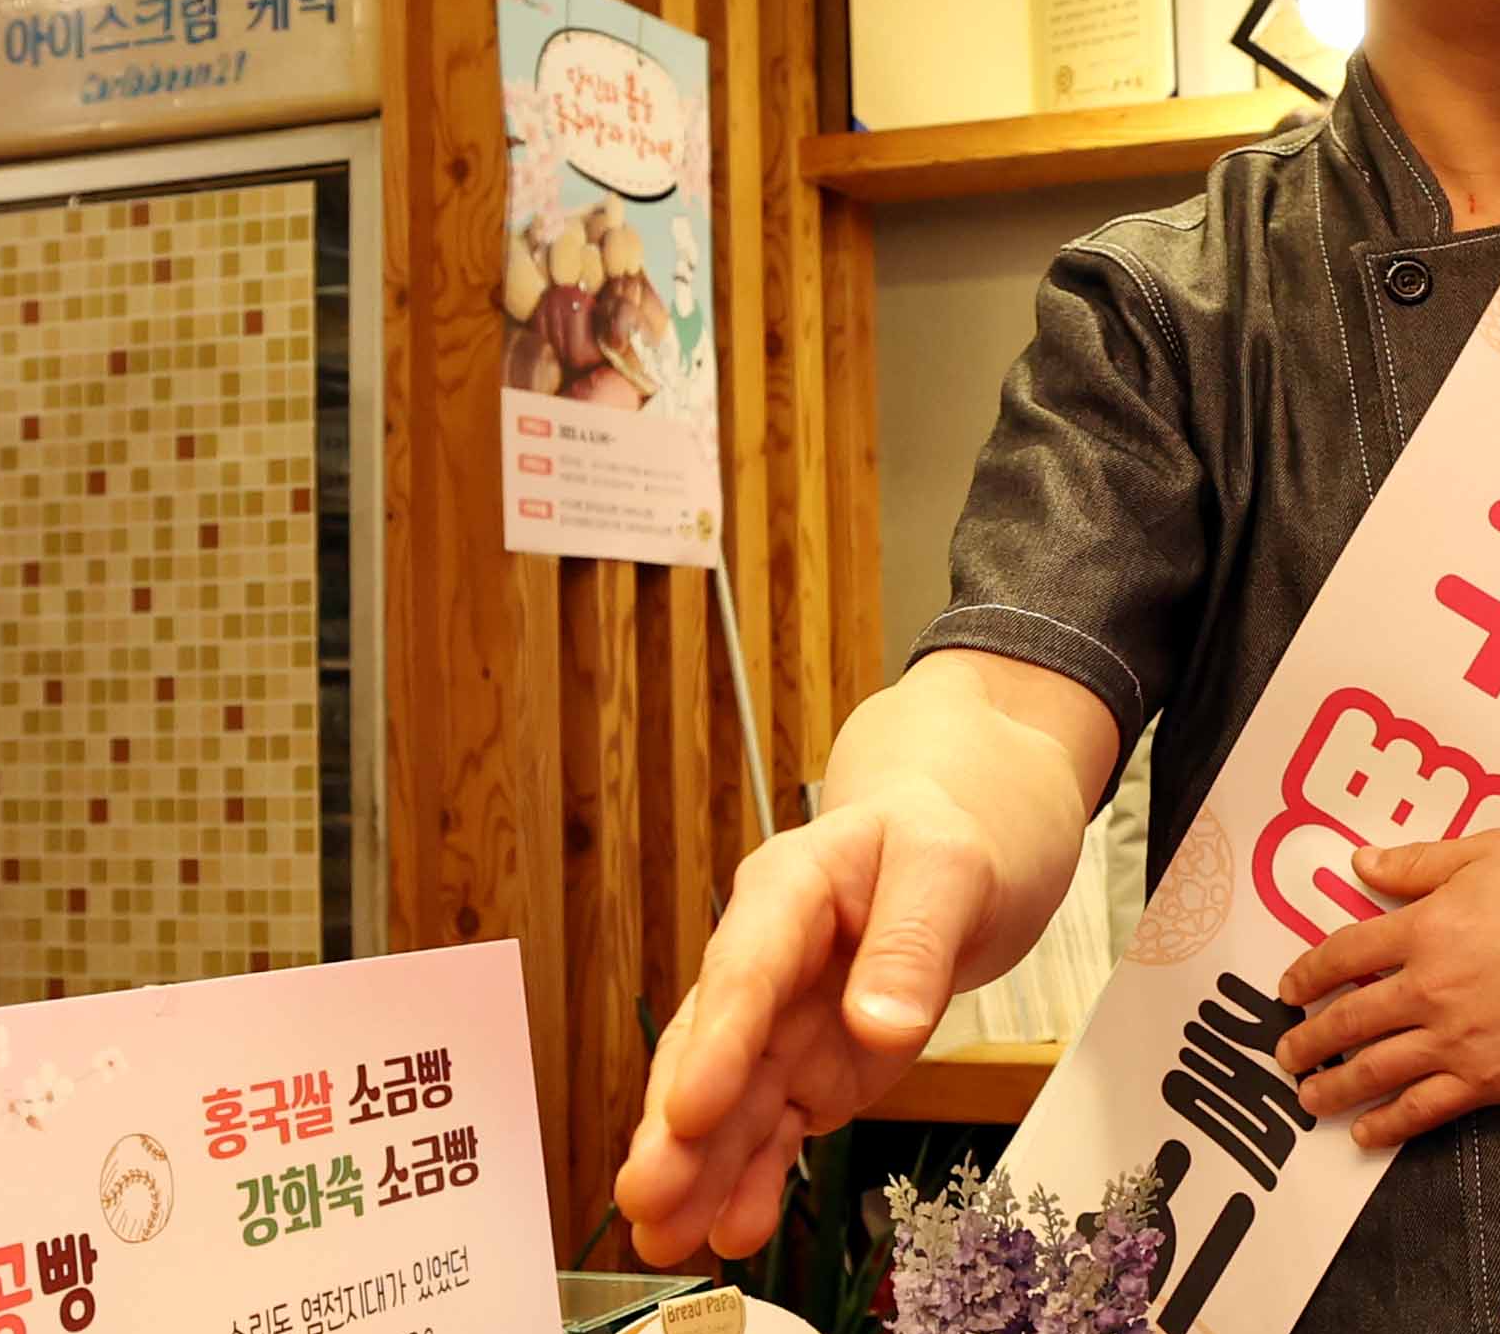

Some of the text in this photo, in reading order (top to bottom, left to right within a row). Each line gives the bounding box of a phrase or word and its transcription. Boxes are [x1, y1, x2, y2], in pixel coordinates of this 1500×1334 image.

[201, 1047, 454, 1160] 홍국쌀 소금빵
[235, 1125, 480, 1248] 강화쑥 소금빵
[413, 1244, 471, 1302] 있었던
[666, 1298, 702, 1324] Bread
